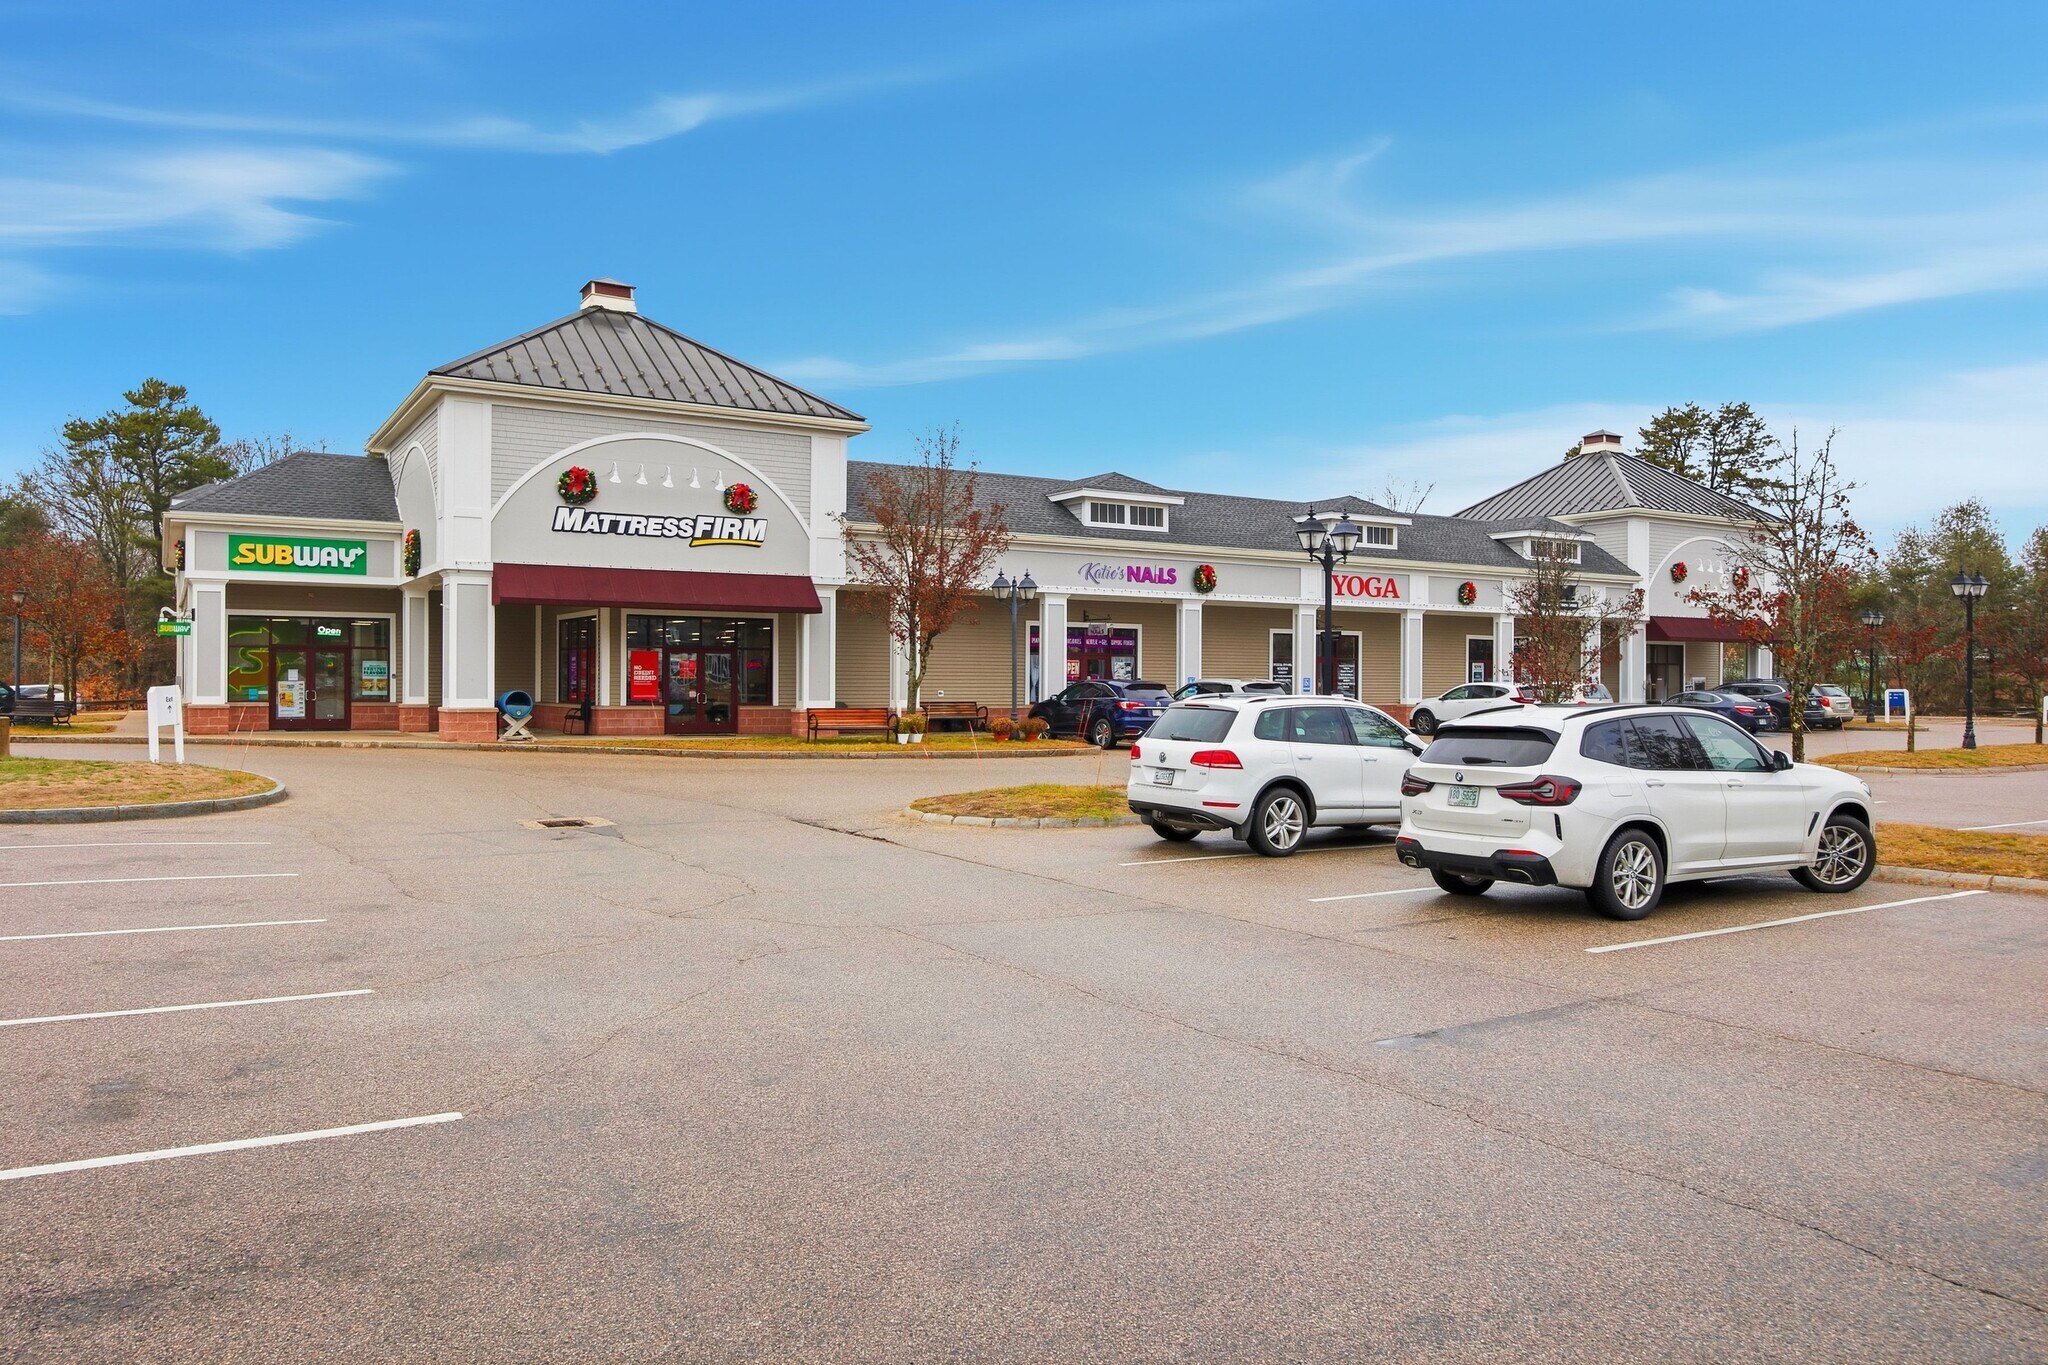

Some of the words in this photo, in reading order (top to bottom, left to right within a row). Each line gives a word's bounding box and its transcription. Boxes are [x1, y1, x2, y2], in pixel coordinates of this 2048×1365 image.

[232, 543, 365, 568] SUBWAY
[1078, 562, 1124, 584] Katie's
[1126, 564, 1177, 585] NAILS
[1332, 574, 1400, 598] YOGA
[159, 624, 190, 632] SUBWAY
[317, 626, 341, 635] Open
[1067, 662, 1079, 675] PEN
